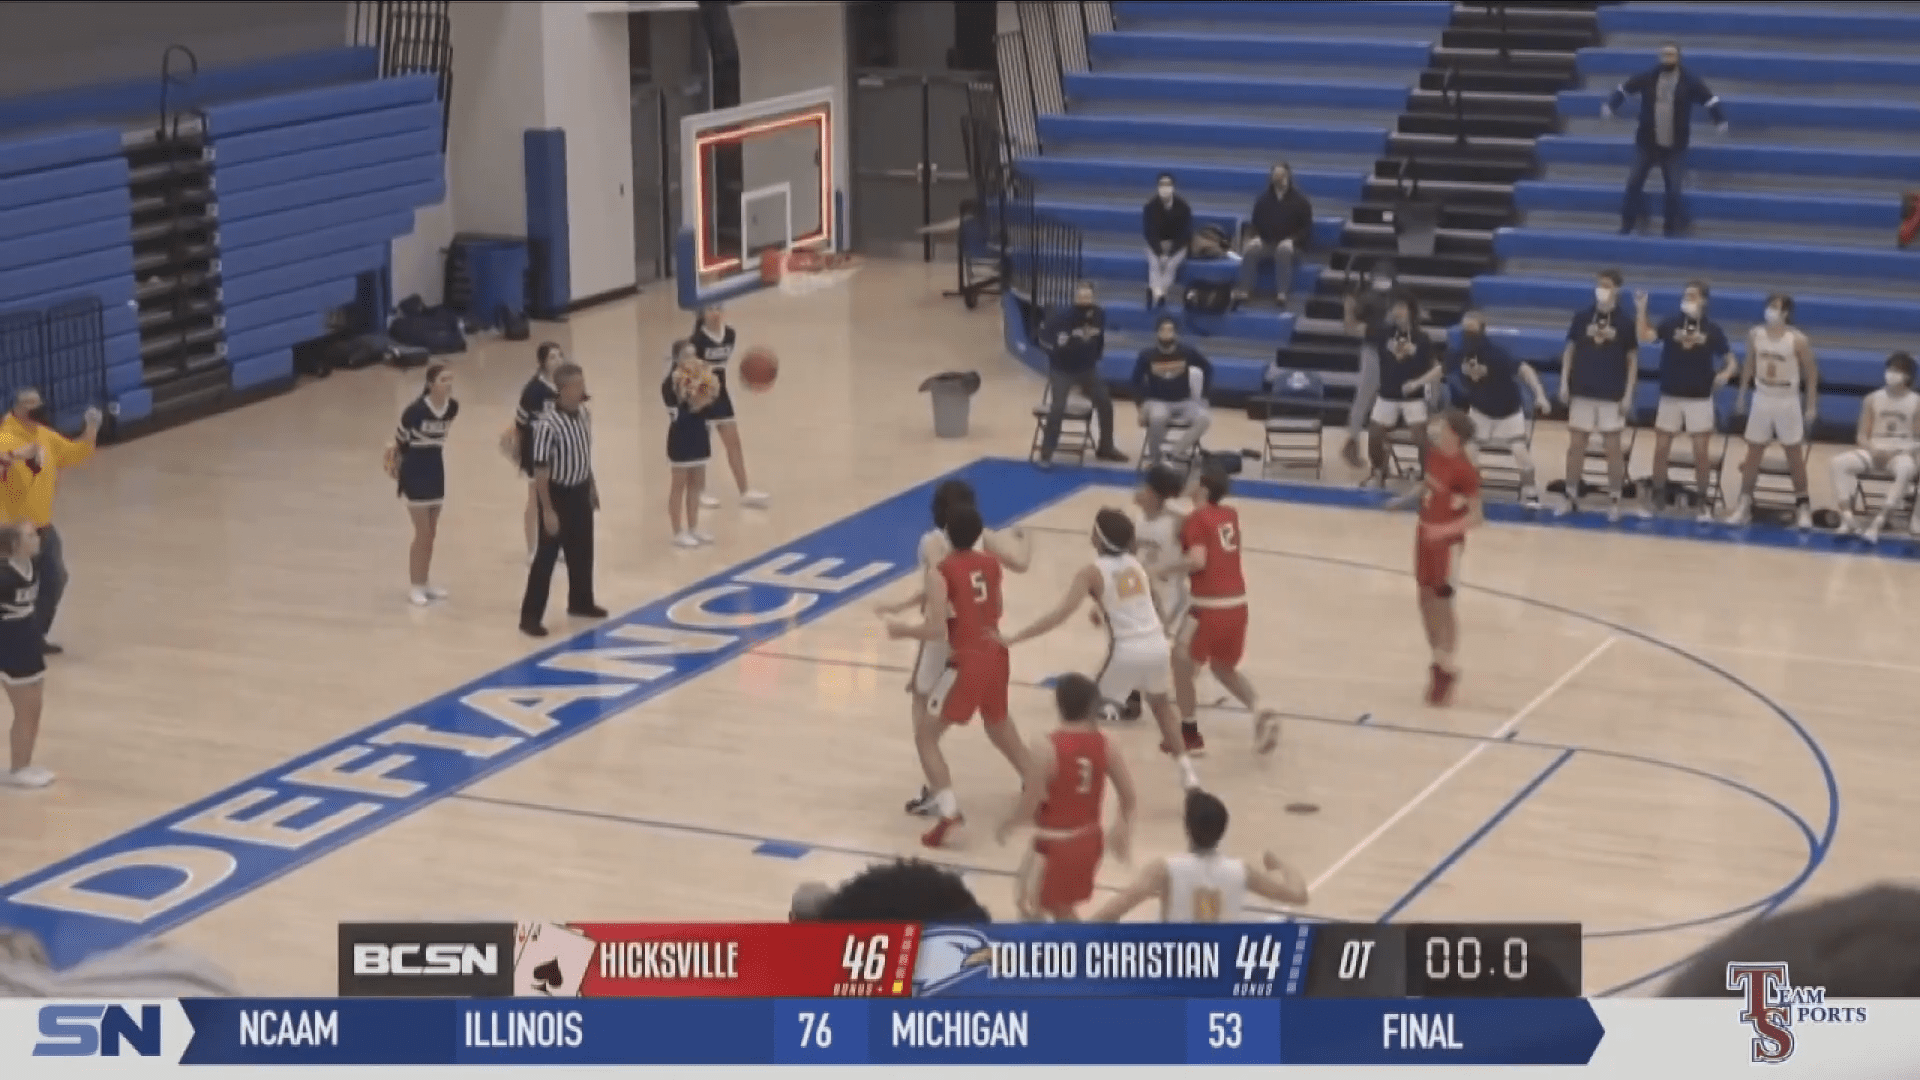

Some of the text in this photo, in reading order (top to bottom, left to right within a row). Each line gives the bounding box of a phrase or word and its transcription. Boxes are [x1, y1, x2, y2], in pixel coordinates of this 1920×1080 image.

[969, 570, 988, 602] 5
[6, 551, 896, 923] DEFIANCE
[1074, 758, 1092, 793] 3
